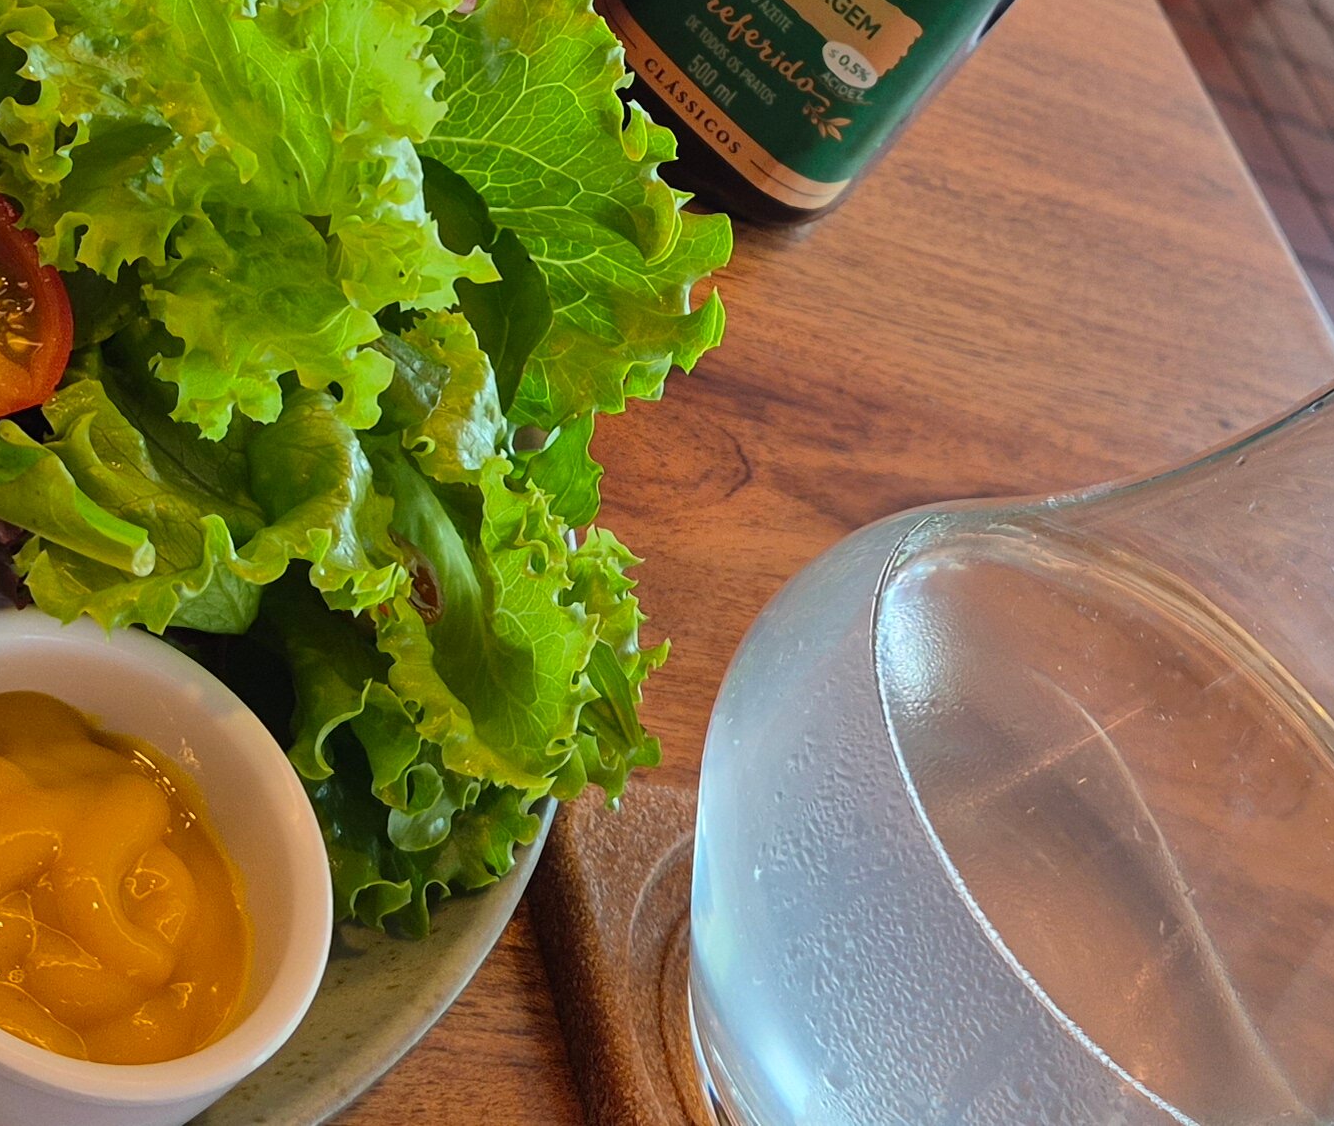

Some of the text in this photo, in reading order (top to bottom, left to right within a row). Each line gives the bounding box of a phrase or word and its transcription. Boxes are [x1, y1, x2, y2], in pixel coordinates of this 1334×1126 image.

[760, 0, 794, 33] AZEITE
[685, 14, 777, 105] DE TODOS OS PRATOS
[687, 54, 738, 107] 500 ml
[644, 58, 741, 155] CLÁSSICOS
[820, 72, 866, 101] ACIDEZ
